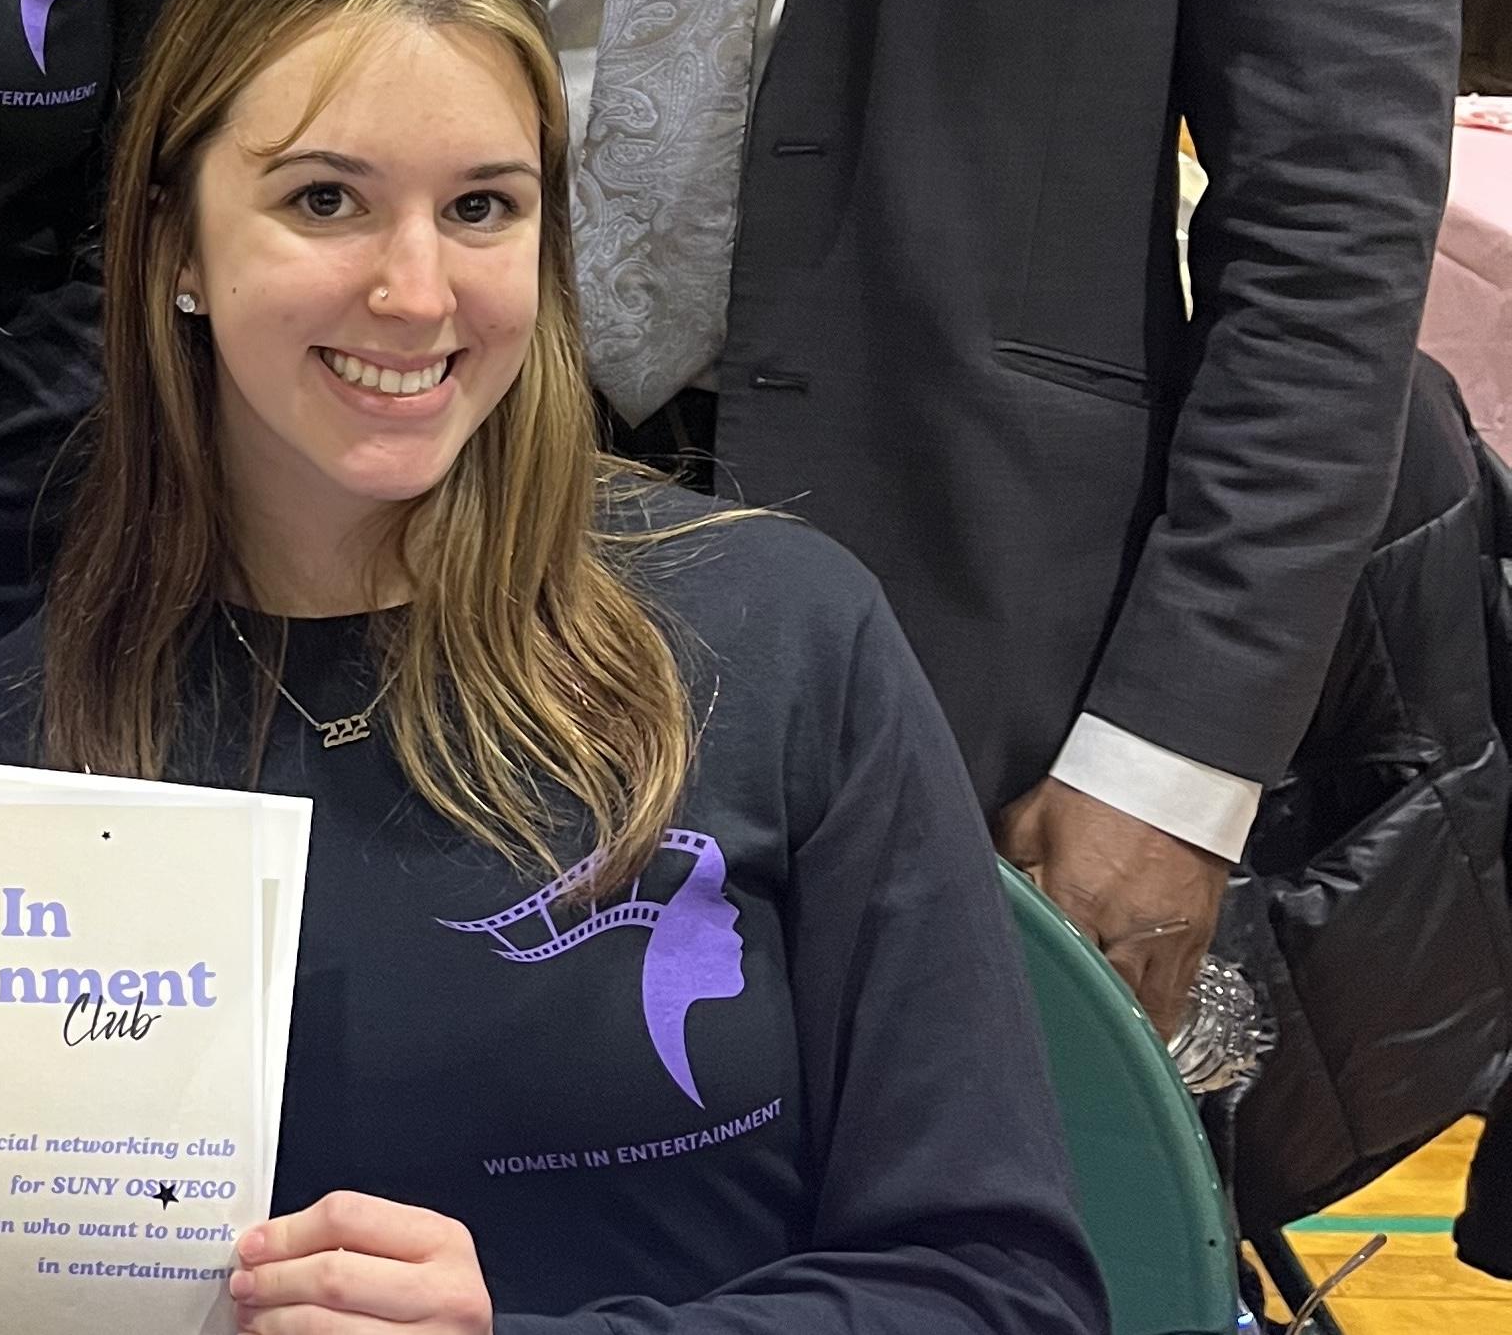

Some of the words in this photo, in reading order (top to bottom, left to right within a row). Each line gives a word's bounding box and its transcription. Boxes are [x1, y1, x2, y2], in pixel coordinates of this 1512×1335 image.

[1, 887, 71, 938] In
[63, 991, 162, 1047] Club
[45, 1136, 179, 1160] networking
[186, 1138, 235, 1157] club
[483, 1152, 577, 1176] WOMEN
[584, 1149, 610, 1168] IN
[617, 1097, 783, 1165] ENTERTAINMENT
[10, 1174, 45, 1196] for
[51, 1176, 119, 1196] SUNY
[23, 1217, 71, 1236] who
[78, 1221, 139, 1238] want
[145, 1222, 168, 1240] to
[176, 1223, 235, 1241] work
[37, 1256, 60, 1274] in
